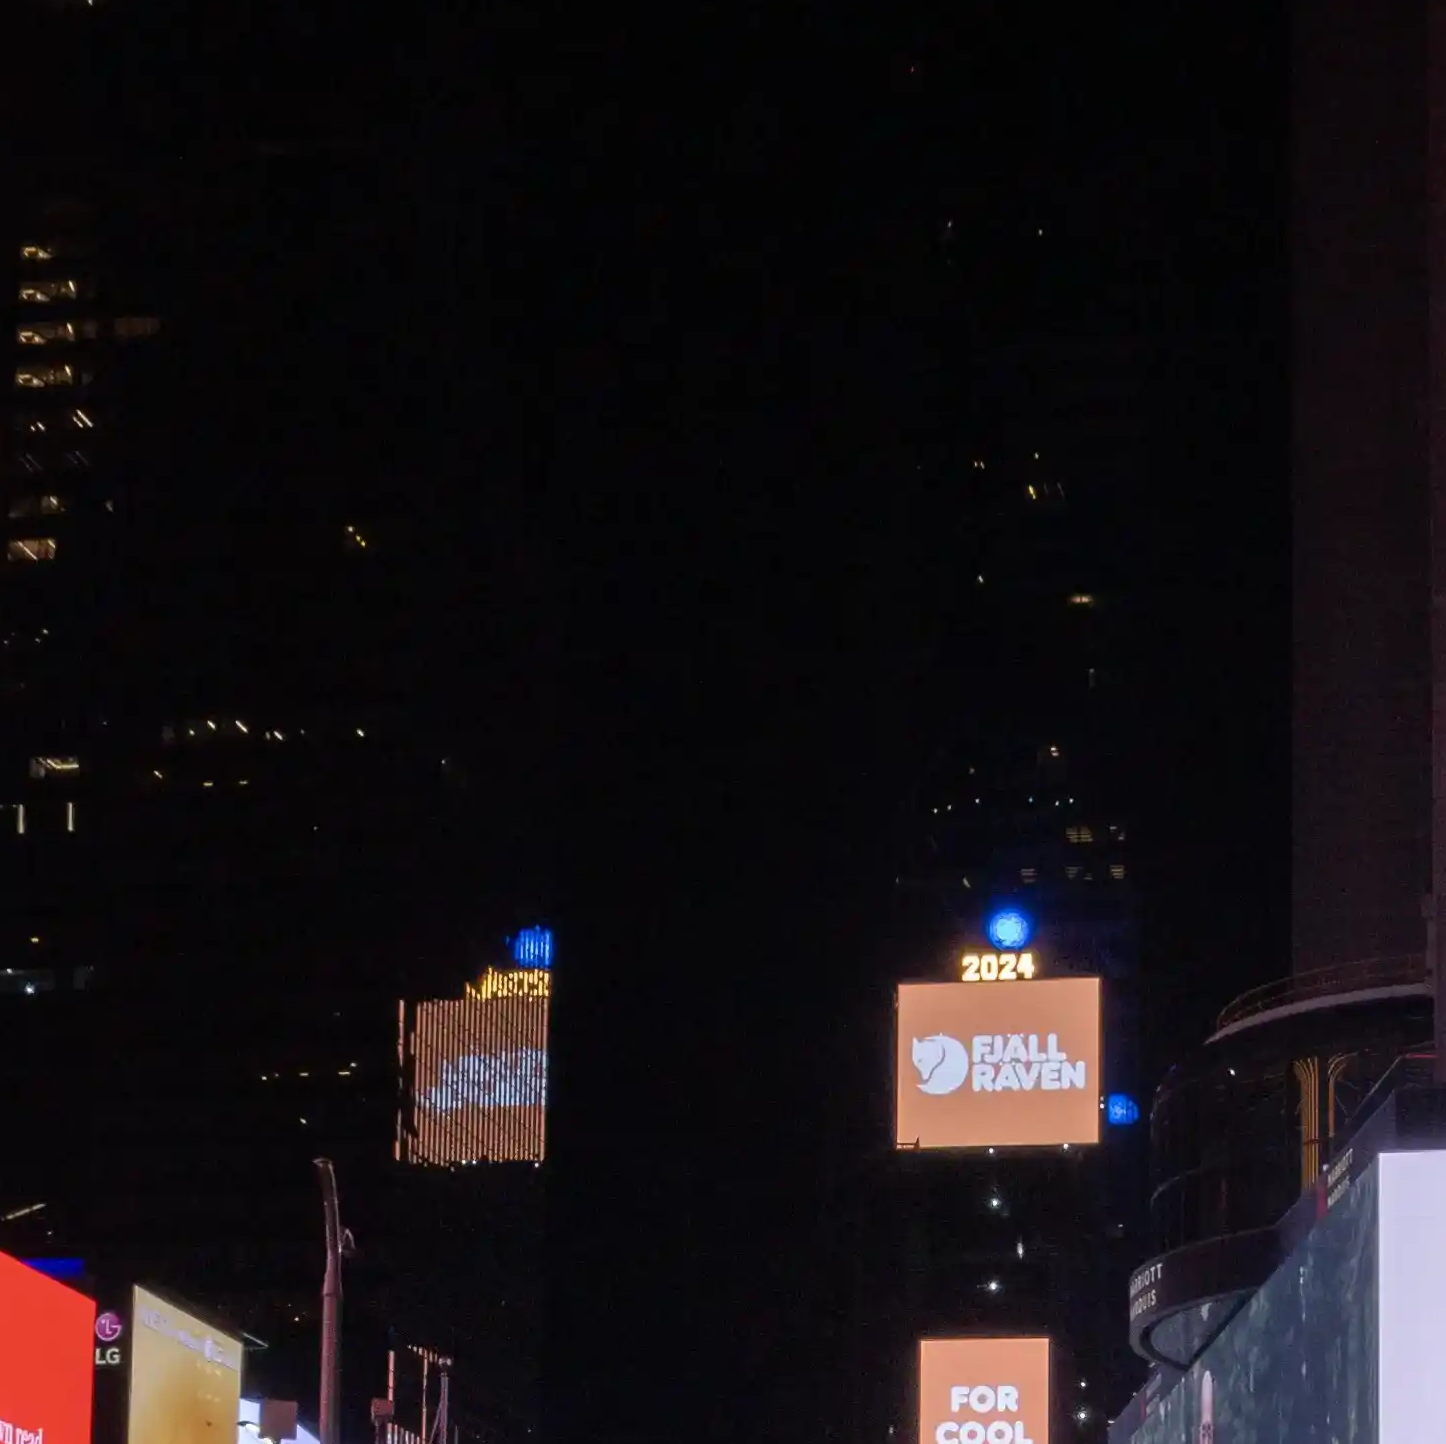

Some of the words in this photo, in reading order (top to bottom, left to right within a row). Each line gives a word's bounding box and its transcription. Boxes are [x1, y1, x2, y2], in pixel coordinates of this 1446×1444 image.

[961, 952, 1035, 982] 2024
[972, 1033, 1067, 1063] FJÄLL
[972, 1061, 1087, 1092] RÄVEN
[95, 1347, 121, 1365] LG
[951, 1385, 1018, 1413] FOR
